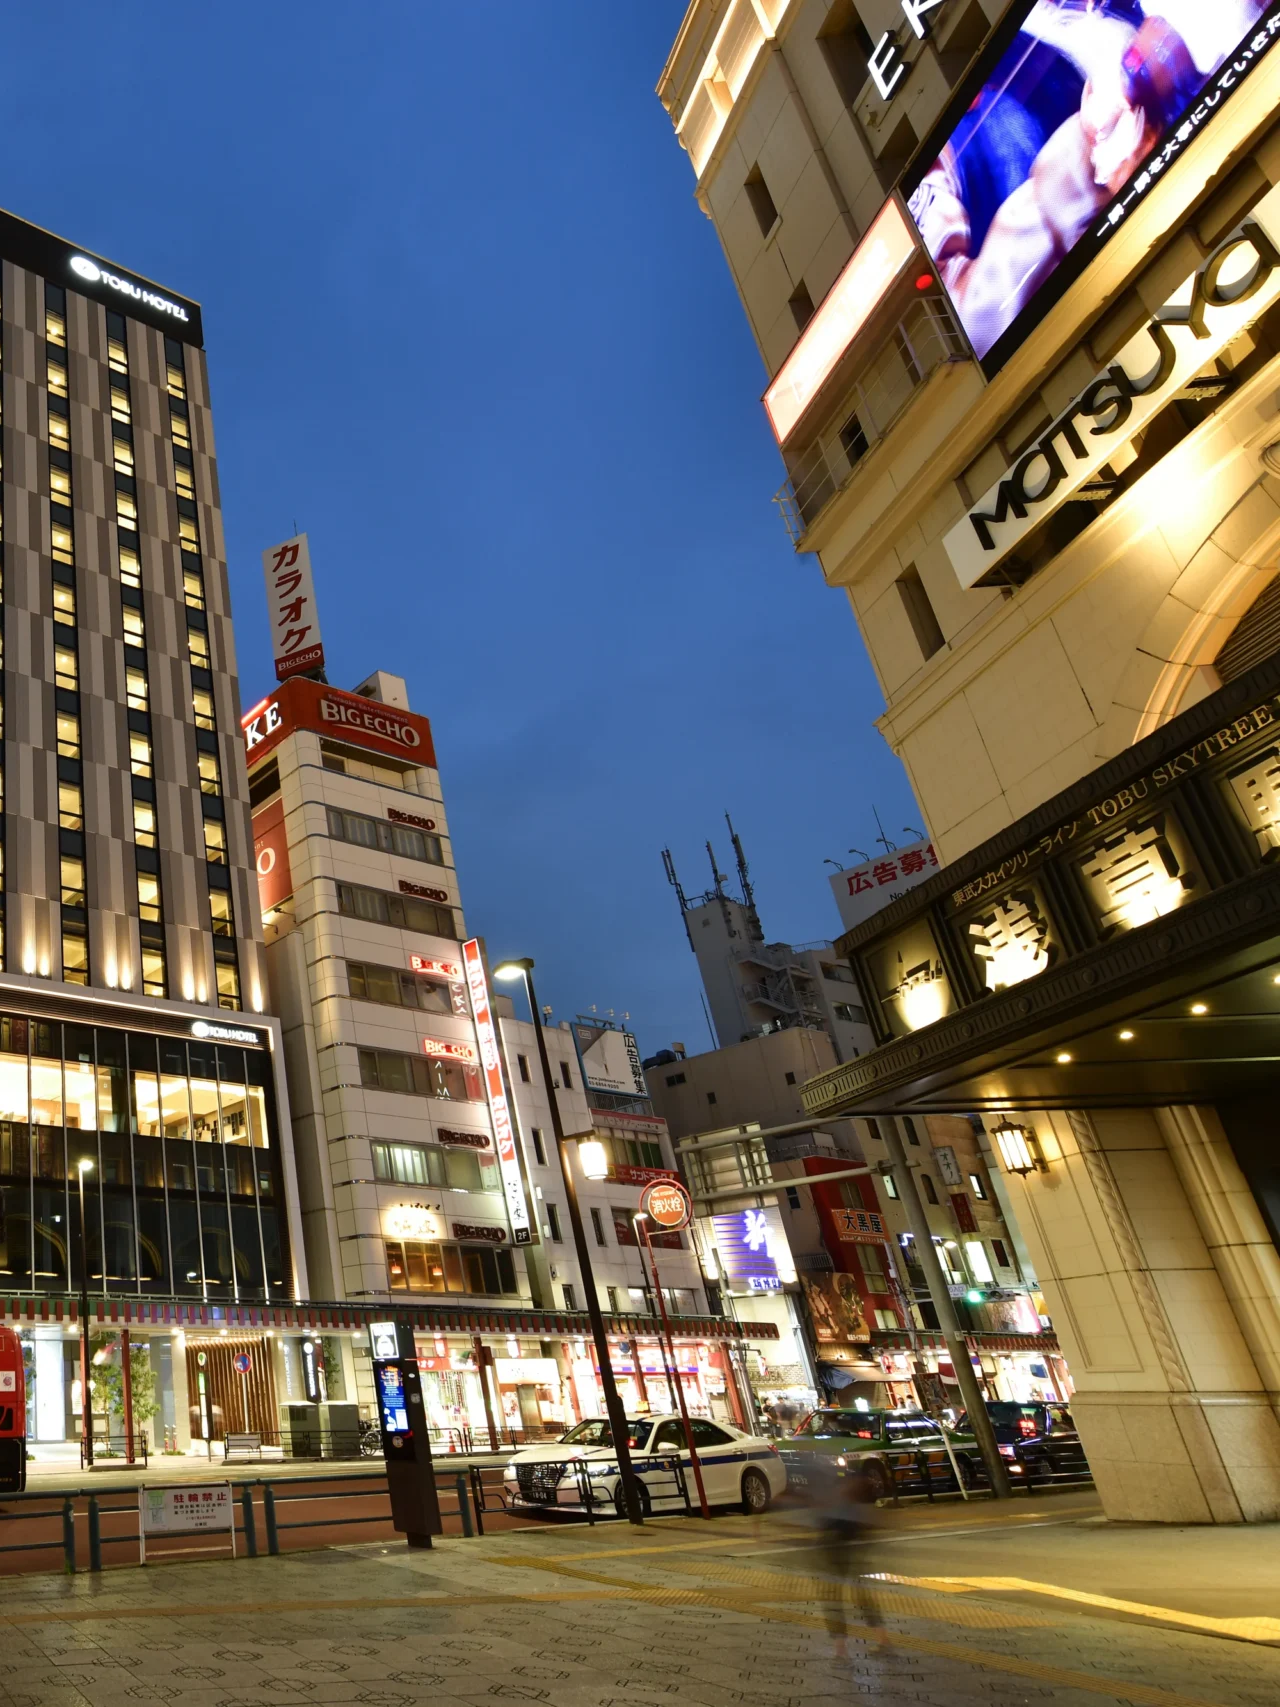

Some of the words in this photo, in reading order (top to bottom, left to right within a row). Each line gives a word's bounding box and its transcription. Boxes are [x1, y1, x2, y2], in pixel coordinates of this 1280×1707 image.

[101, 271, 141, 298] TOBU
[143, 291, 189, 321] HOTEL
[272, 543, 312, 655] カラオケ
[320, 699, 361, 725] BIG
[364, 711, 421, 748] ECHO
[1086, 776, 1149, 827] TOBU
[1151, 703, 1275, 790] SKYTREE
[951, 820, 1081, 908] 東武スカイツリーライン
[623, 1032, 647, 1095] 広告募集
[651, 1197, 682, 1214] 消火栓
[843, 1212, 884, 1233] 大黒屋
[517, 1231, 527, 1240] 2F
[173, 1491, 228, 1504] 駐輪禁止
